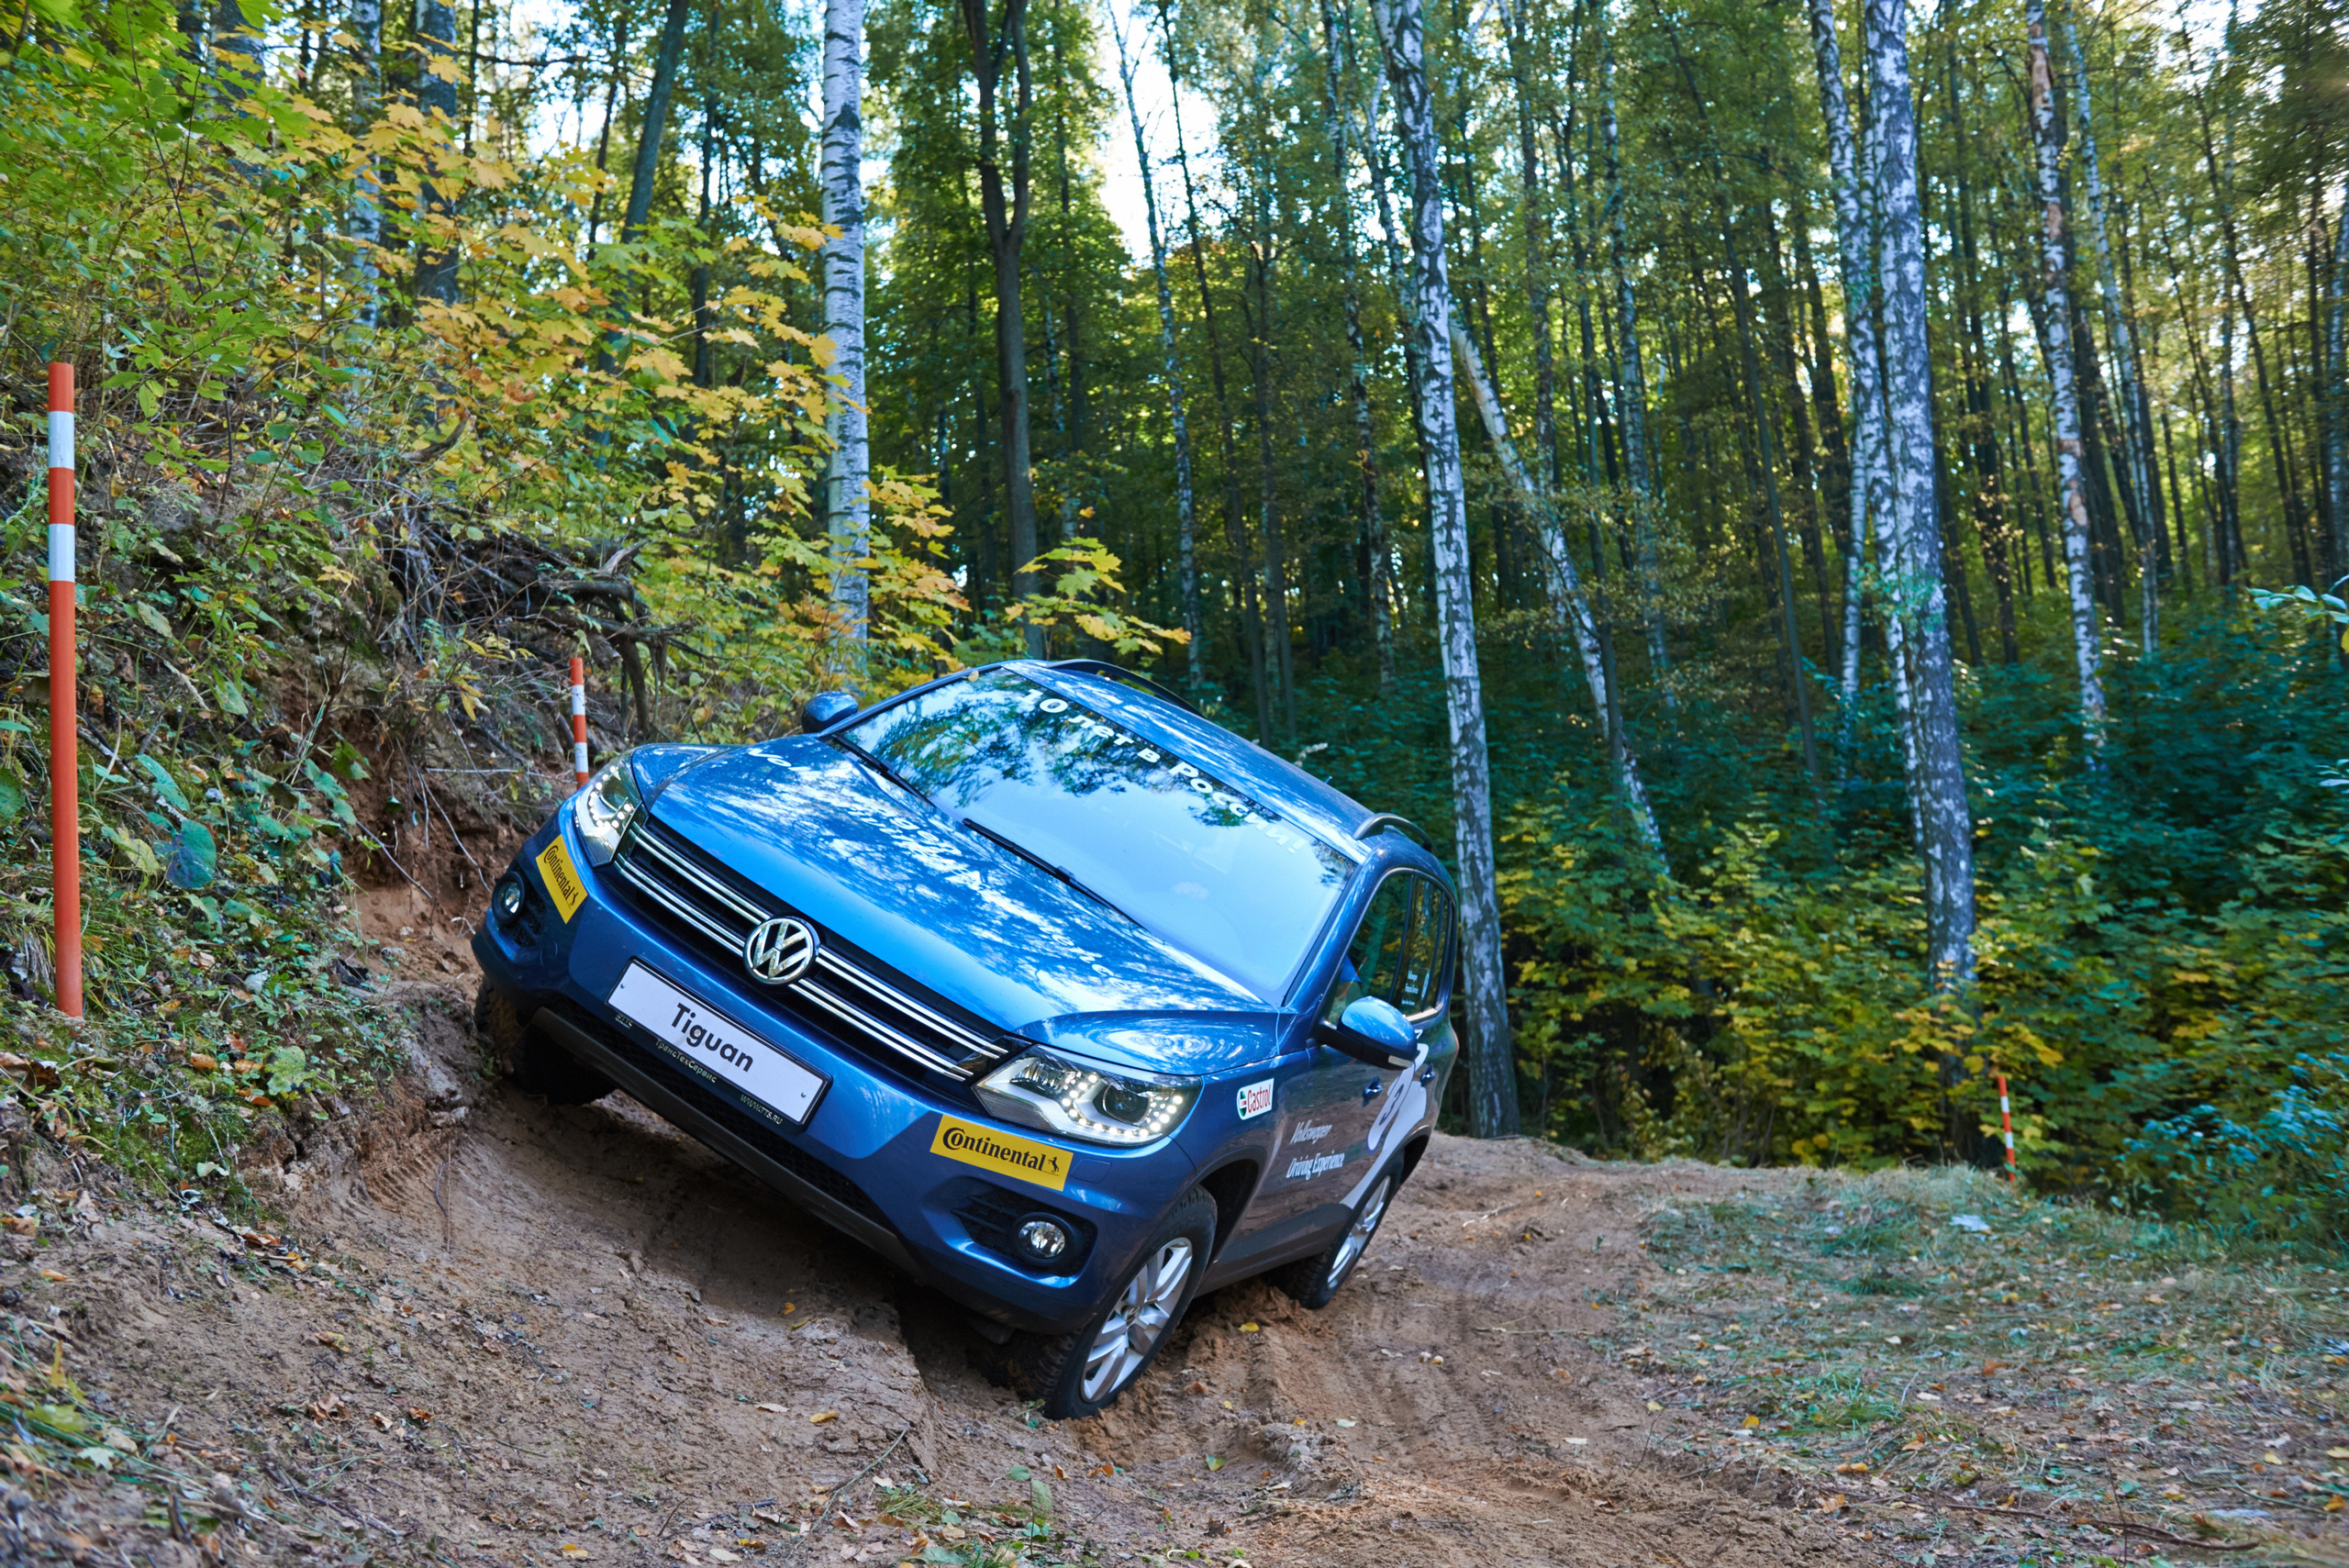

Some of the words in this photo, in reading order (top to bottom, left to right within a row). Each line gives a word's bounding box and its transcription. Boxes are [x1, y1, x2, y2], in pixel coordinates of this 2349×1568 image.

[1017, 689, 1068, 713] 10
[1068, 715, 1134, 746] лет
[1137, 748, 1161, 763] в
[1169, 762, 1309, 853] России!
[543, 845, 575, 900] Continental
[671, 1002, 754, 1072] Tiguan
[655, 1038, 718, 1083] ТрансТехСервис
[1248, 1084, 1272, 1113] Castrol
[942, 1127, 1046, 1172] Continental
[1290, 1119, 1332, 1144] Volkswagen
[1286, 1155, 1314, 1181] Driving
[1312, 1150, 1345, 1178] Experience
